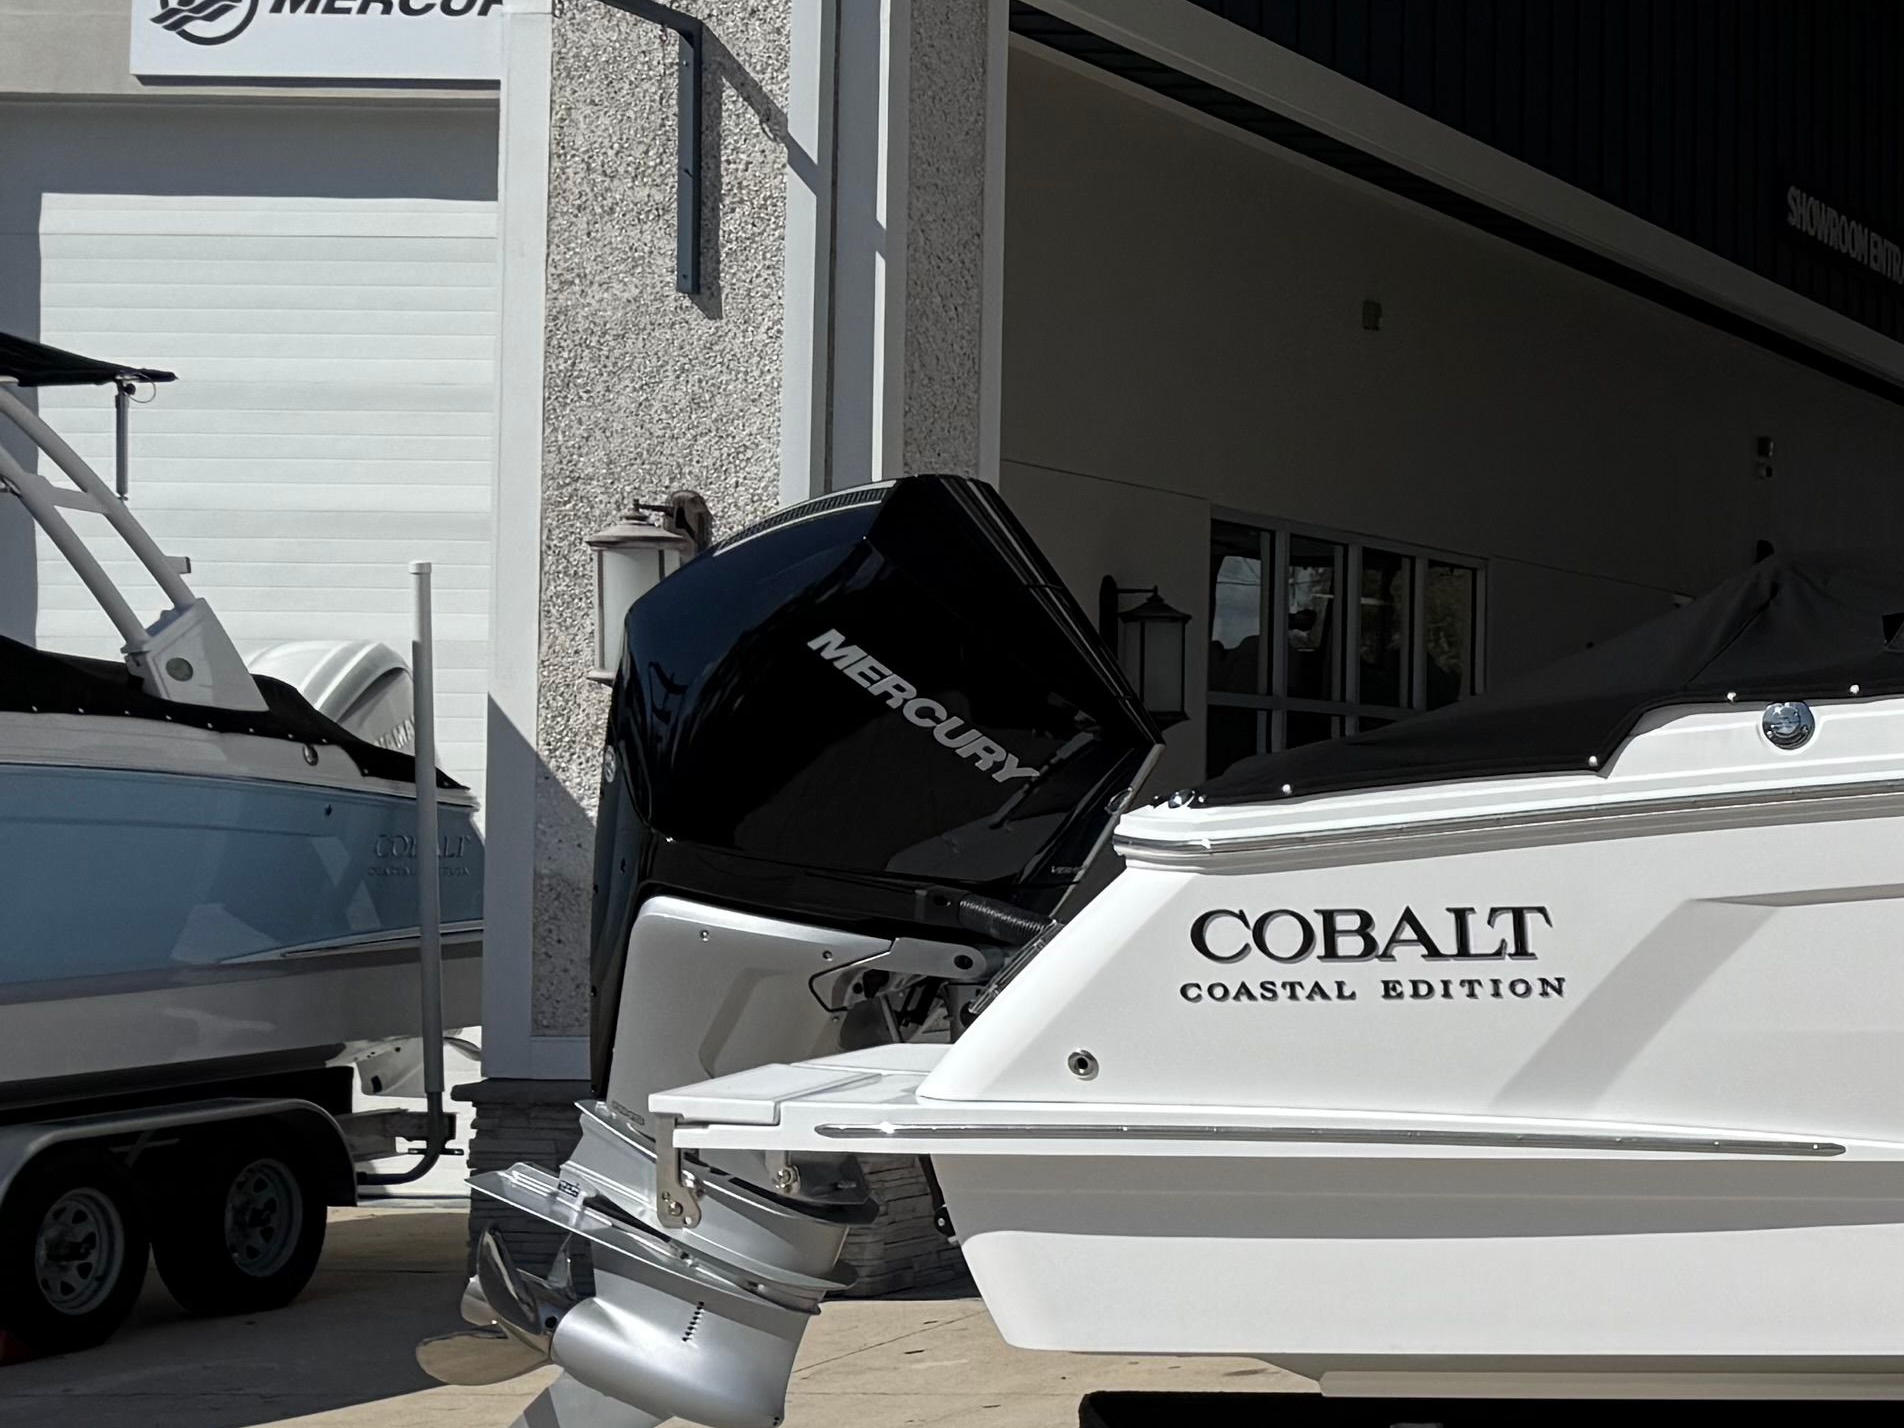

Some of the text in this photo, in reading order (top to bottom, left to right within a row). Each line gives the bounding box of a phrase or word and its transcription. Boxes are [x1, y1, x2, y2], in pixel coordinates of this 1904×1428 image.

[1786, 184, 1869, 266] SHOWROOM
[806, 628, 1041, 783] MERCURY
[1190, 905, 1553, 963] COBALT
[1179, 976, 1566, 1003] COASTAL EDITION
